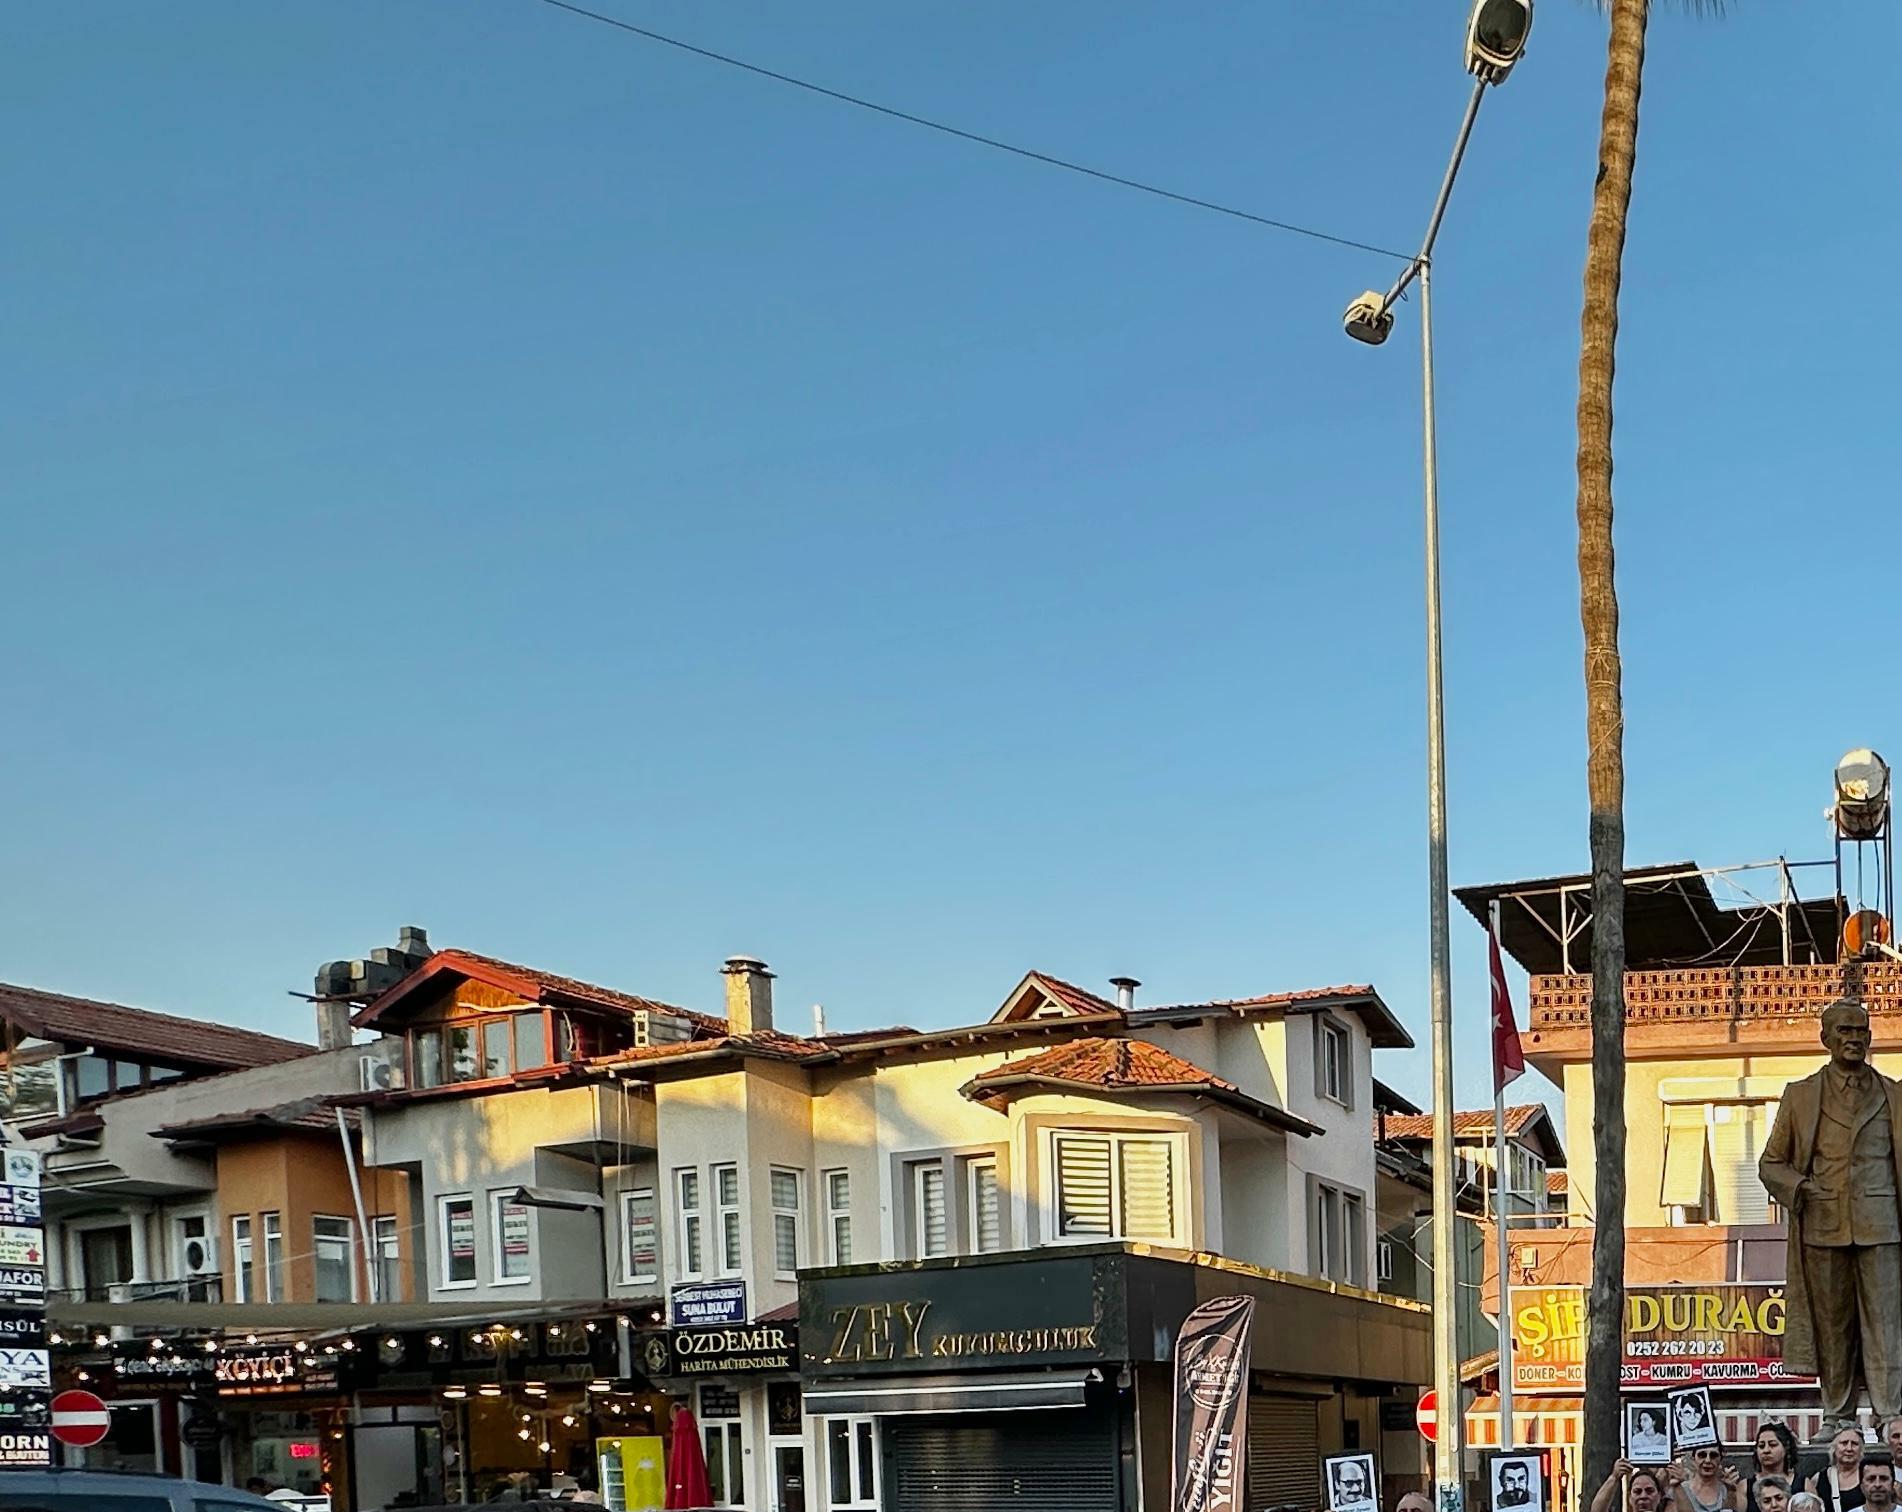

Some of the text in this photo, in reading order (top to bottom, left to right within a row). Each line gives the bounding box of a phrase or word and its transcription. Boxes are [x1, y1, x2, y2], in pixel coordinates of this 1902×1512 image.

[1628, 1288, 1786, 1336] DURAĞ
[675, 1326, 787, 1355] ÖZDEMİR
[830, 1300, 932, 1361] ZEY
[1627, 1340, 1724, 1356] 0252 262 20 23
[681, 1355, 789, 1373] HARİTA MÜHENDİSLİK
[1652, 1365, 1691, 1379] KUMRU
[1703, 1364, 1758, 1379] KAVURMA
